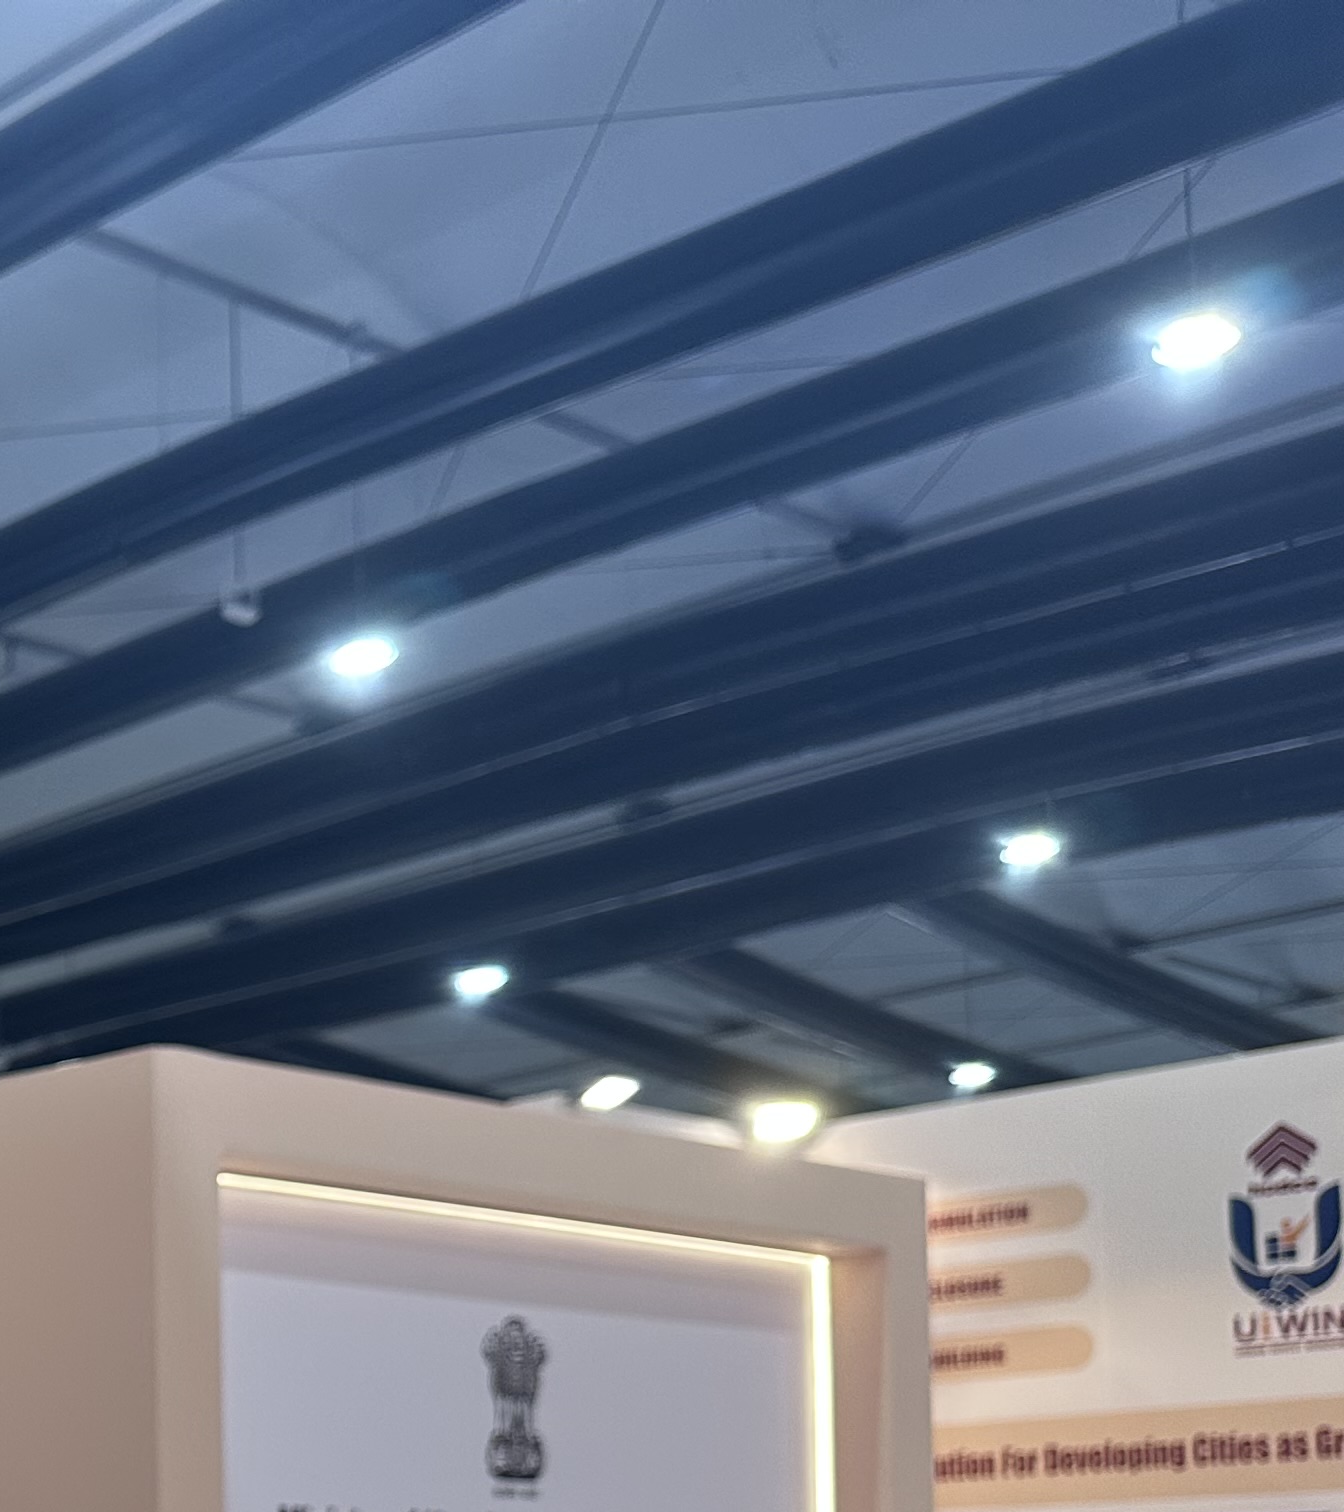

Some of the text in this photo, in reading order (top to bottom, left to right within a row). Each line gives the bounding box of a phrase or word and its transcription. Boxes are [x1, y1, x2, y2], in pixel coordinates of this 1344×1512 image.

[1001, 1444, 1038, 1480] For
[1043, 1437, 1187, 1477] Developing
[1193, 1430, 1271, 1469] Cities
[1276, 1430, 1309, 1463] as
